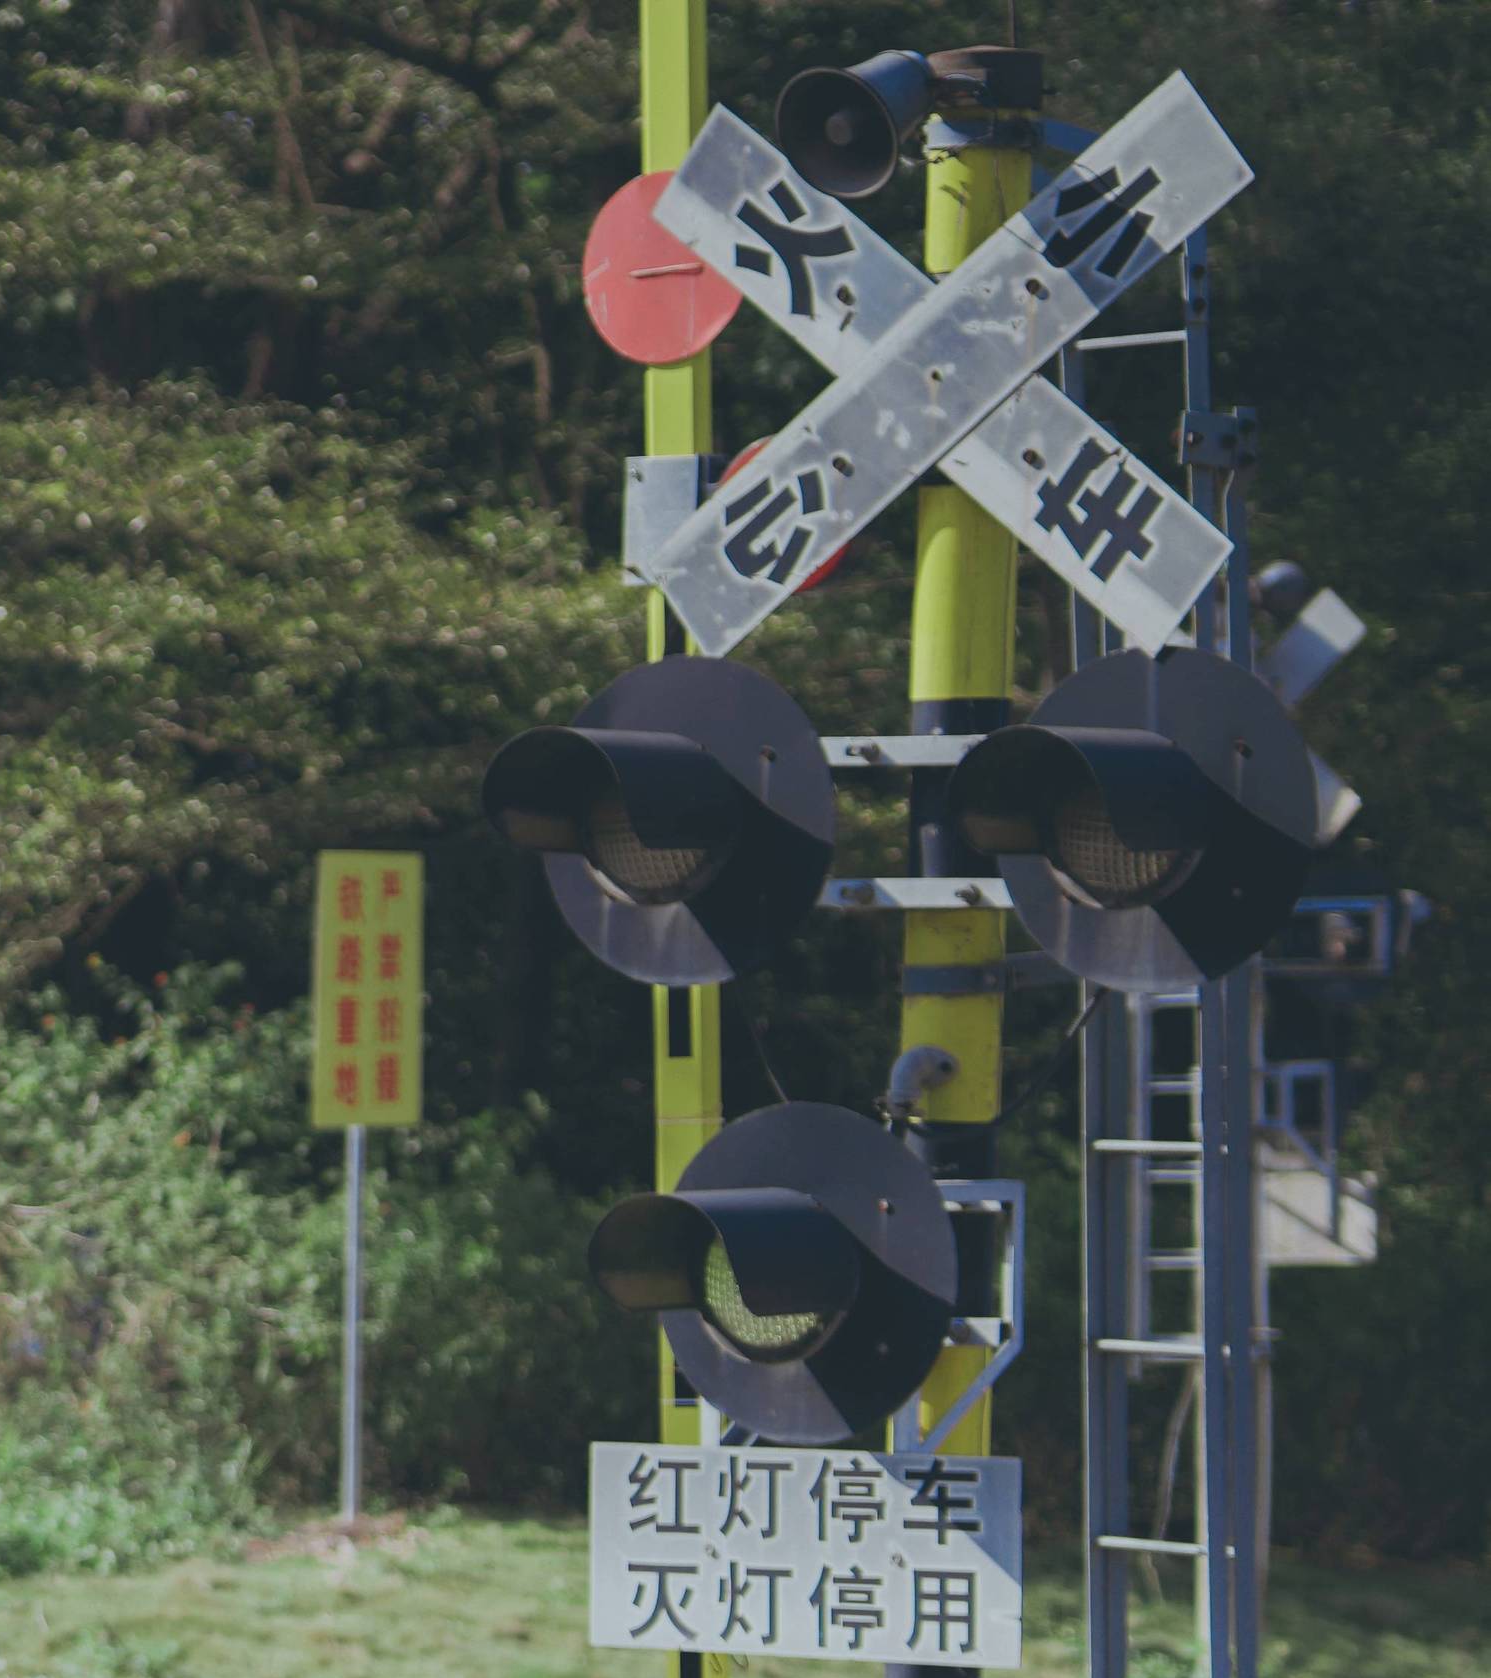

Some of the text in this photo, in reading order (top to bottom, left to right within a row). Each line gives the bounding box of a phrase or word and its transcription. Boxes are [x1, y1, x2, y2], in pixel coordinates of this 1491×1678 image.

[628, 1453, 981, 1545] 红灯停车
[628, 1561, 977, 1653] 灭灯停用
